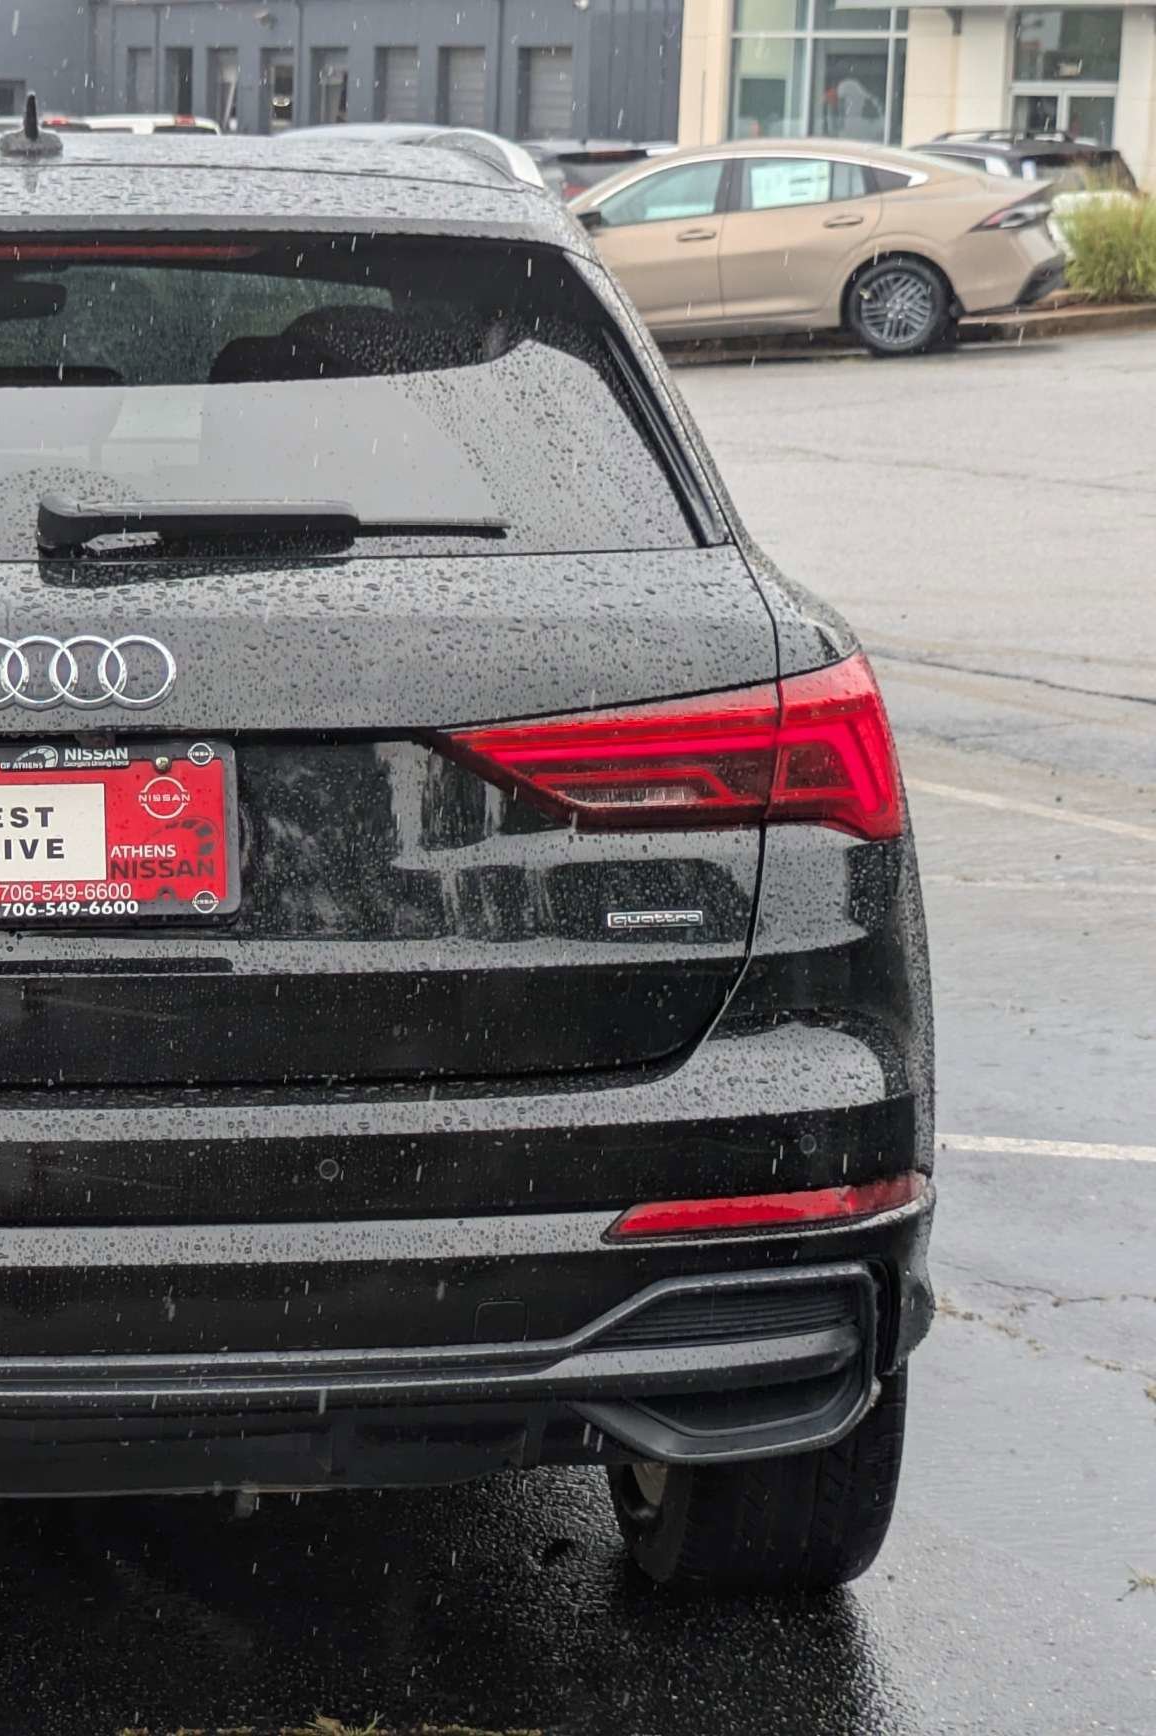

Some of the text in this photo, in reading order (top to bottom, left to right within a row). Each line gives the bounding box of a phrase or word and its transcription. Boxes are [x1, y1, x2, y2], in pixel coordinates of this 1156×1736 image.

[64, 747, 129, 761] NISSAN
[139, 792, 190, 803] NISSAN
[110, 844, 177, 858] ATHENS
[111, 859, 214, 879] NISSAN
[1, 901, 139, 917] 706-549-6600
[613, 914, 700, 926] quattro
